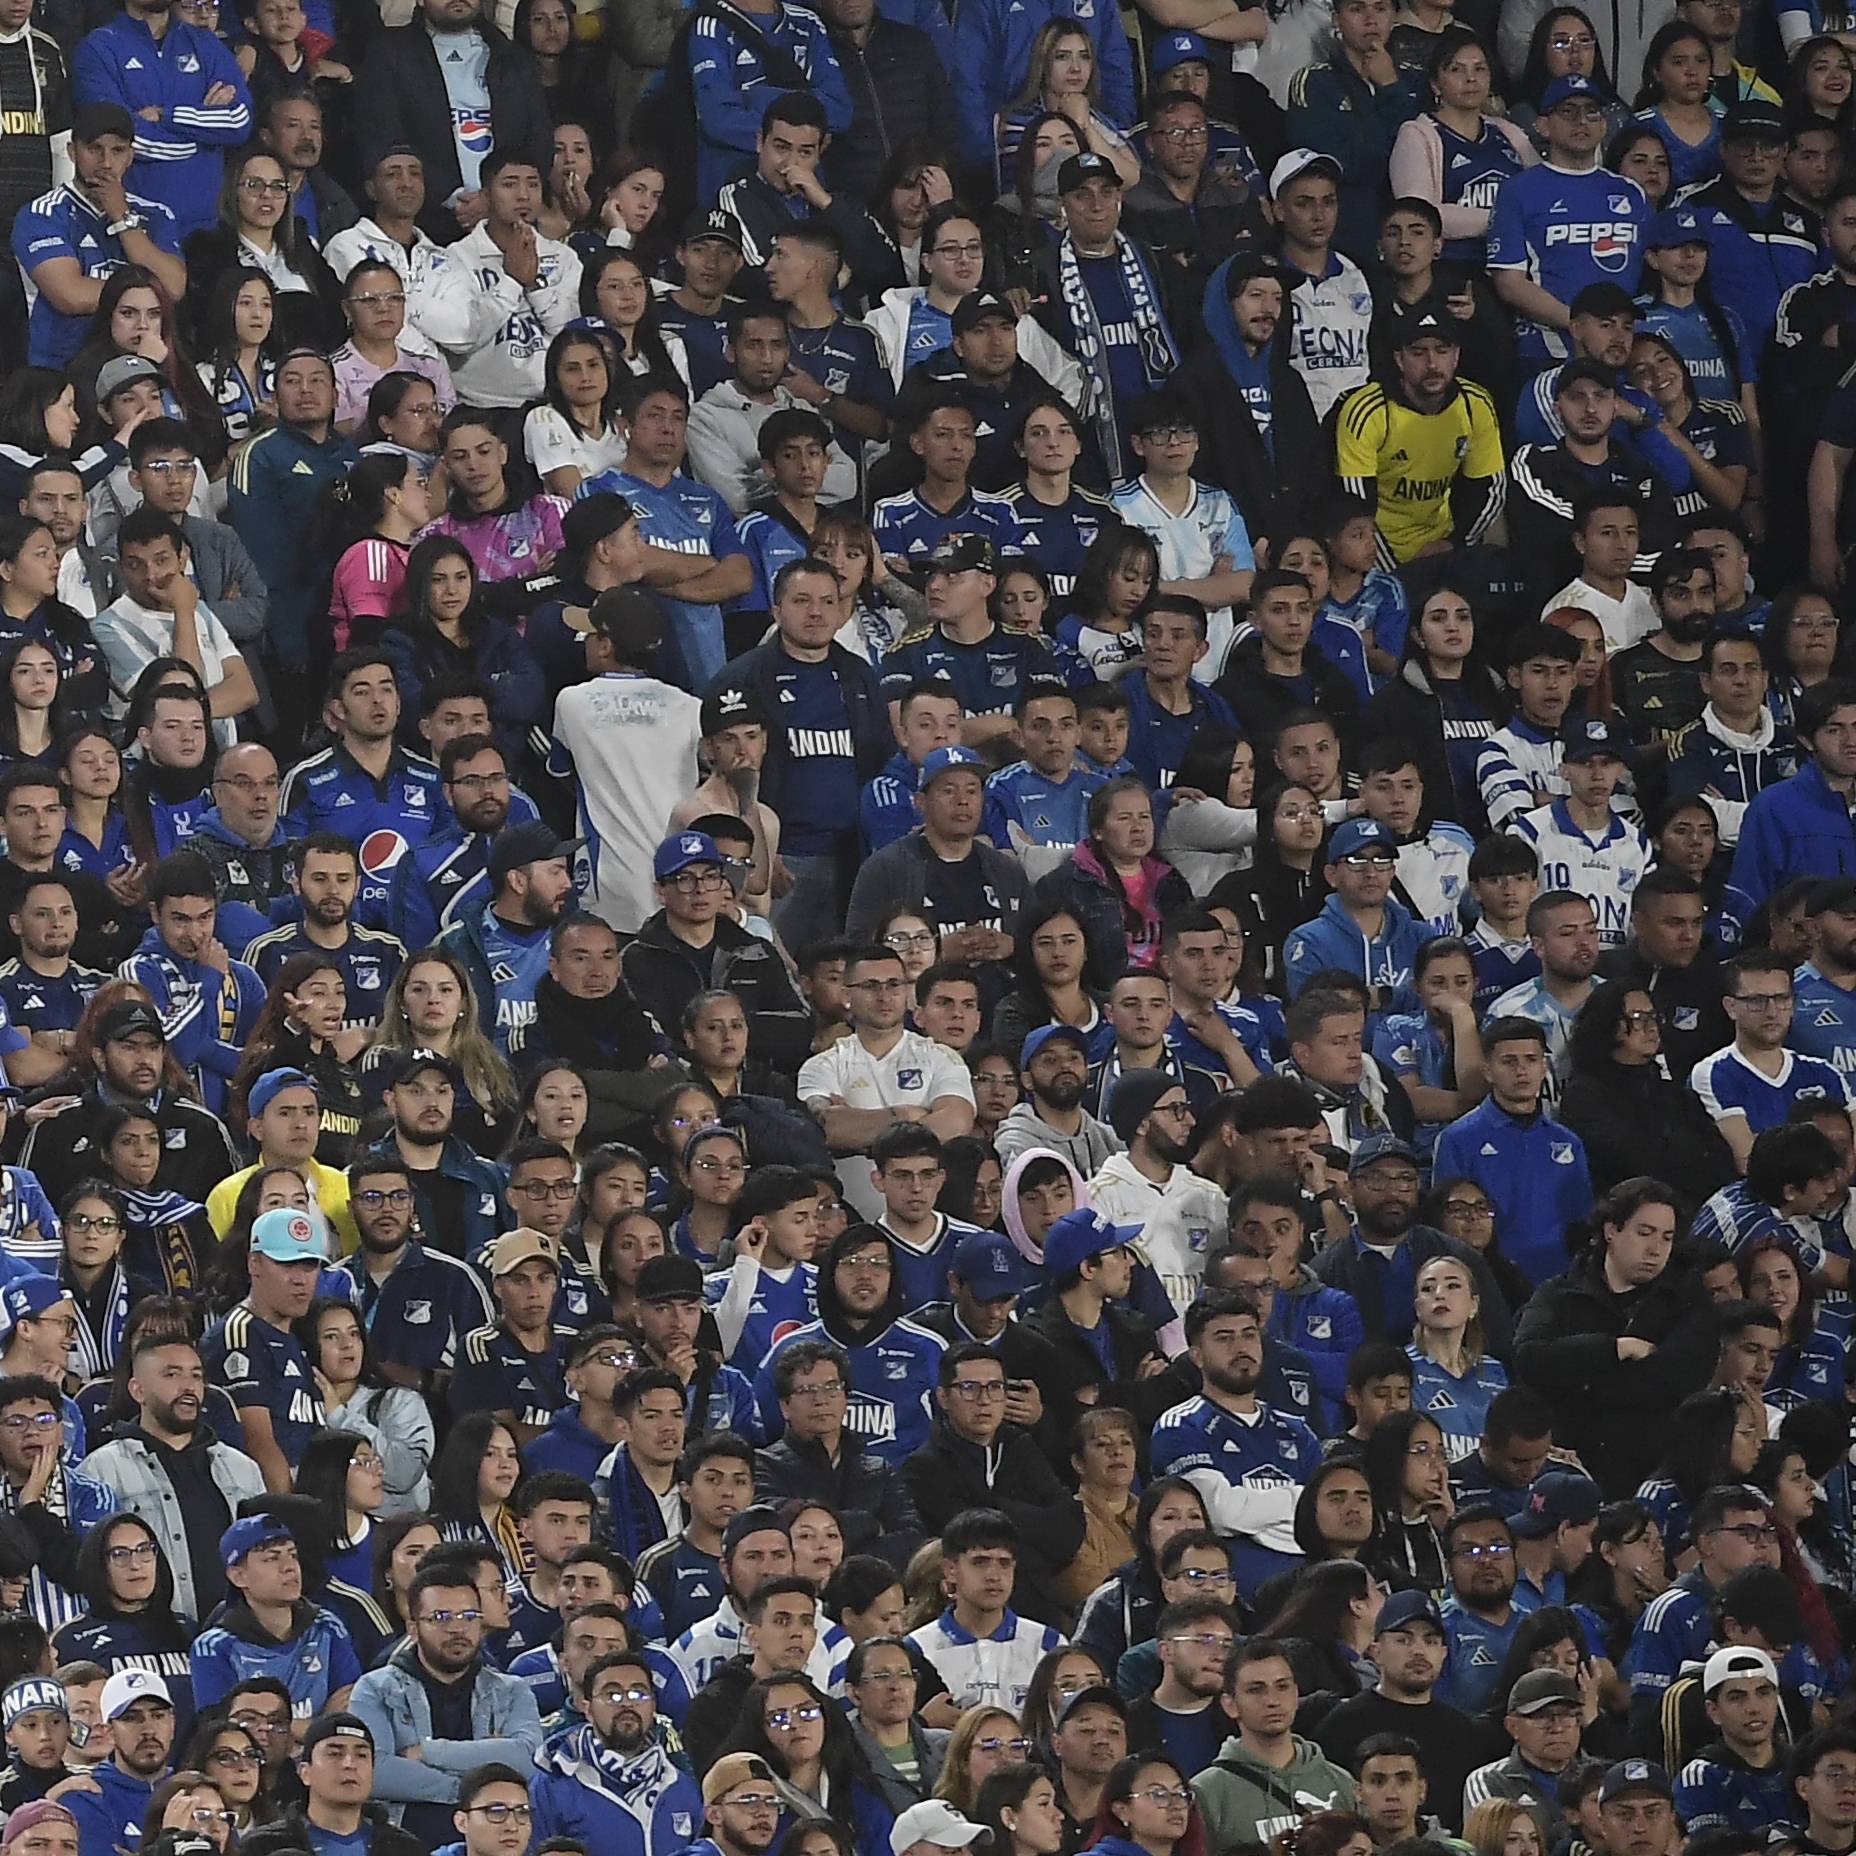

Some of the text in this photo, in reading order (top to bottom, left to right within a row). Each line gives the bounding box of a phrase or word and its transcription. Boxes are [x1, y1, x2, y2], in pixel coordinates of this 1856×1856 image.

[708, 210, 727, 229] NY
[1545, 222, 1637, 247] PEPSI
[1442, 719, 1494, 745] ANDIN
[1542, 862, 1571, 890] 10
